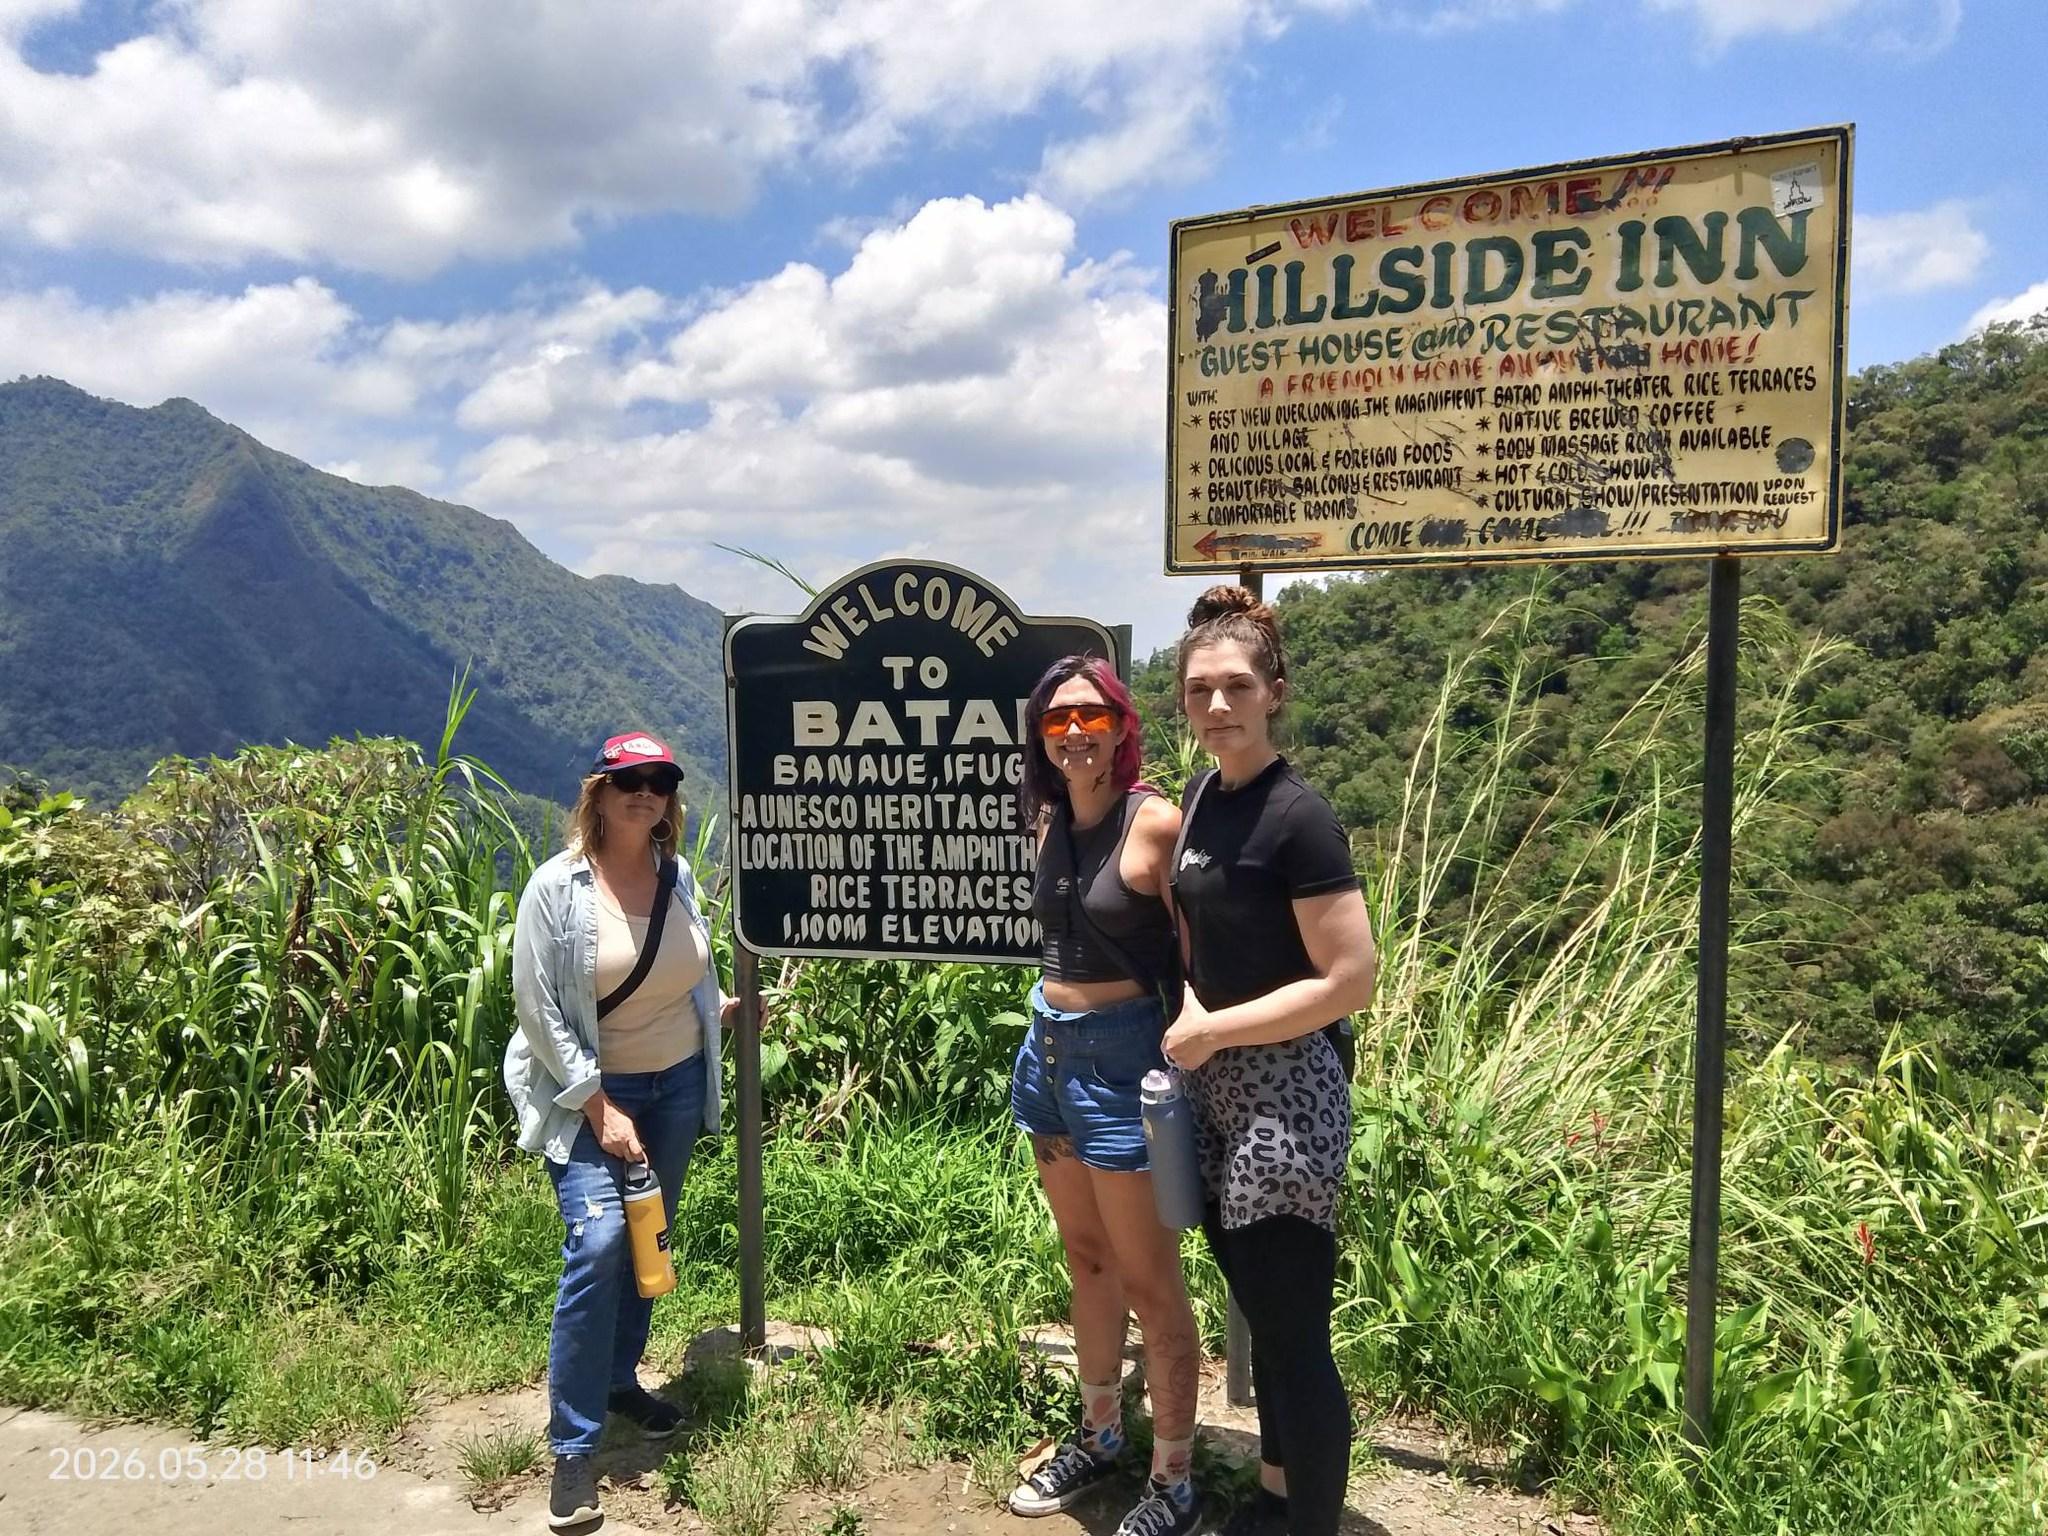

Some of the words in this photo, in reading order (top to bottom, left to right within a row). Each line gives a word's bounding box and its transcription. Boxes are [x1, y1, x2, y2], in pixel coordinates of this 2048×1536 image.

[1195, 227, 1592, 338] HILLSIDE
[1616, 207, 1813, 292] INN
[1201, 339, 1289, 377] GUEST
[1299, 327, 1404, 364] HOUSE
[1480, 290, 1816, 354] RESTAURANT
[1209, 409, 1237, 430] BEST
[1241, 407, 1271, 428] VIEW
[1275, 399, 1360, 425] OVERLOOKING
[1364, 396, 1389, 417] THE
[1494, 383, 1542, 409] BATAD
[1684, 371, 1724, 397] RICE
[1728, 366, 1817, 394] TERRACES
[1260, 376, 1274, 398] A
[1499, 409, 1561, 433] NATIVE
[1569, 405, 1639, 430] BREWED
[1649, 399, 1715, 426] COFFEE
[1210, 433, 1239, 454] AND
[1248, 427, 1310, 451] VILLAGE
[1279, 450, 1318, 474] LOCAL
[1334, 446, 1398, 470] FOREIGN
[1404, 441, 1453, 465] FOODS
[1495, 437, 1535, 460] BODY
[1541, 433, 1619, 457] MASSAGE
[1679, 426, 1772, 451] AVAILABLE
[1294, 473, 1361, 498] BALCONY
[1373, 466, 1463, 494] RESTAURANT
[1495, 463, 1532, 485] HOT
[1549, 462, 1587, 482] COLD
[1763, 478, 1805, 491] UPON
[1207, 502, 1296, 526] COMFORTABLE
[1304, 498, 1358, 521] ROOMS
[1495, 487, 1573, 511] CULTURAL
[1763, 490, 1817, 506] REQUEST
[1350, 519, 1414, 551] COME
[802, 572, 1020, 660] WELCOME
[882, 655, 948, 690] TO
[792, 698, 1027, 748] BATA
[865, 793, 1017, 831] HERITAGE
[741, 832, 845, 871] LOCATION
[851, 832, 876, 871] OF
[881, 833, 925, 872] THE
[931, 834, 1037, 872] AMPHITH
[810, 873, 871, 910] RICE
[881, 874, 1033, 912] TERRACES
